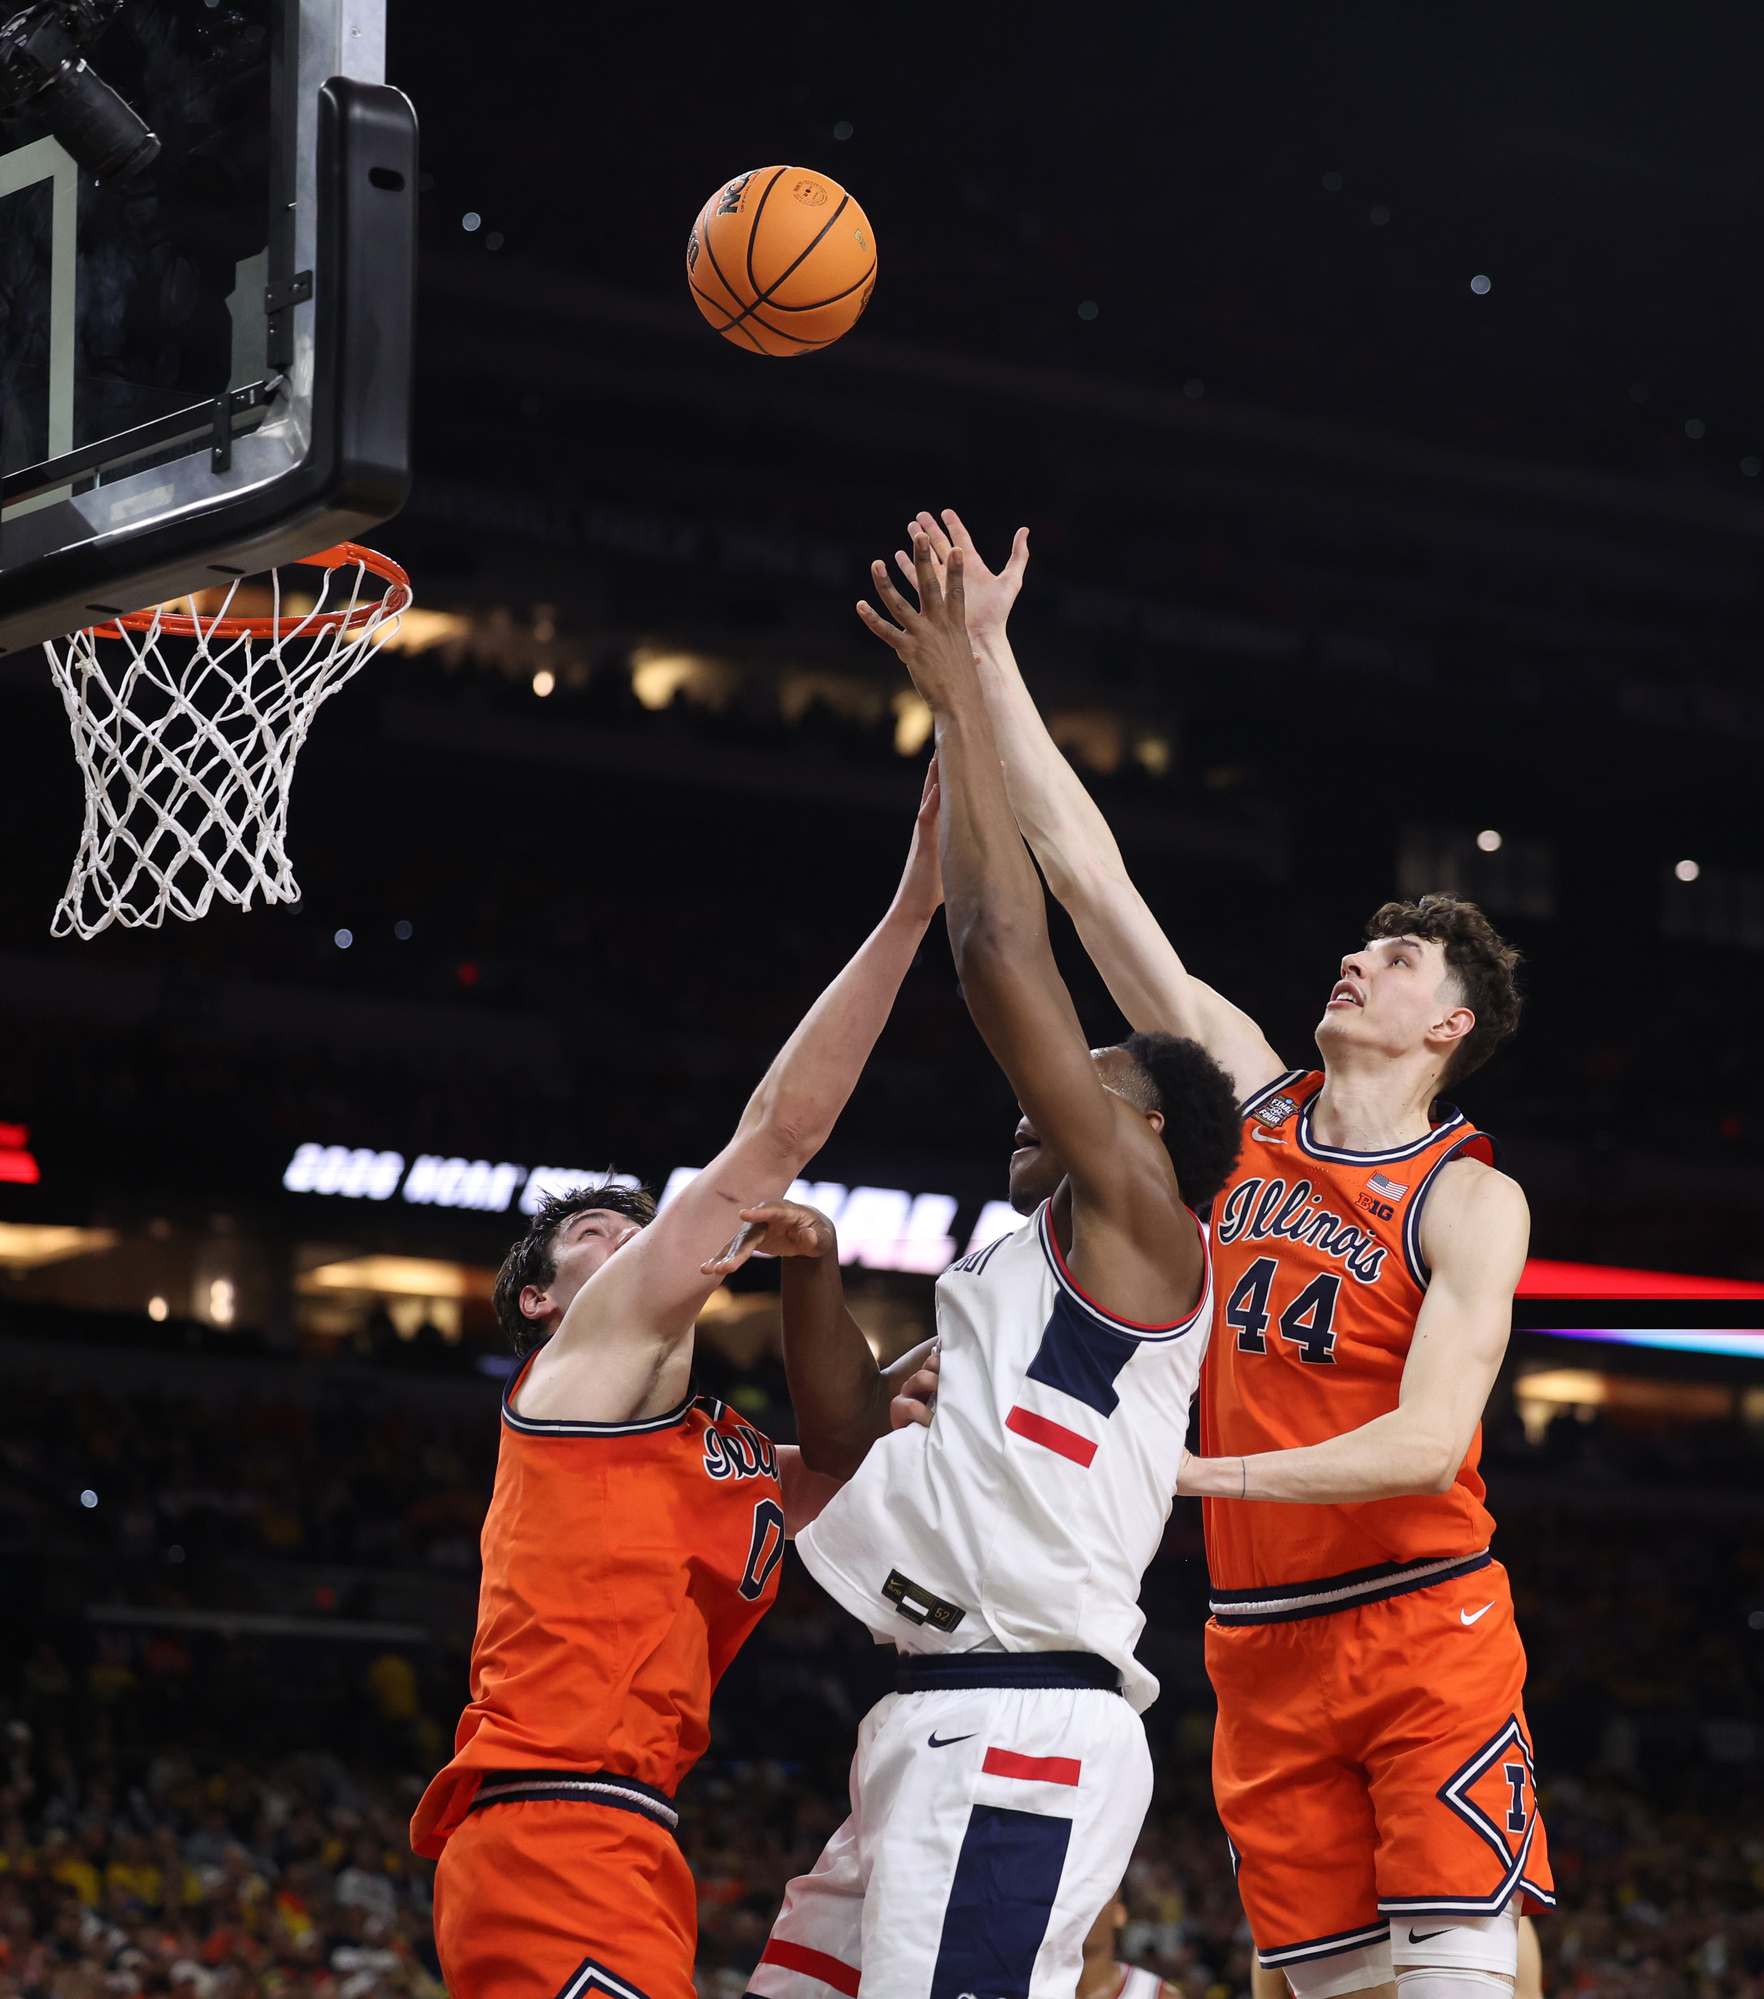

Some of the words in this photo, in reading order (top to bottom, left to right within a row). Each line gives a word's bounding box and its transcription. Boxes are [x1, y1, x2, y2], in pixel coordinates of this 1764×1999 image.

[1258, 1109, 1281, 1124] FOUR
[1271, 1098, 1294, 1114] FINAL
[1217, 1177, 1388, 1284] Illinois
[1226, 1255, 1343, 1365] 44
[737, 1497, 785, 1602] 0
[934, 1607, 951, 1622] 52
[1503, 1763, 1527, 1834] I
